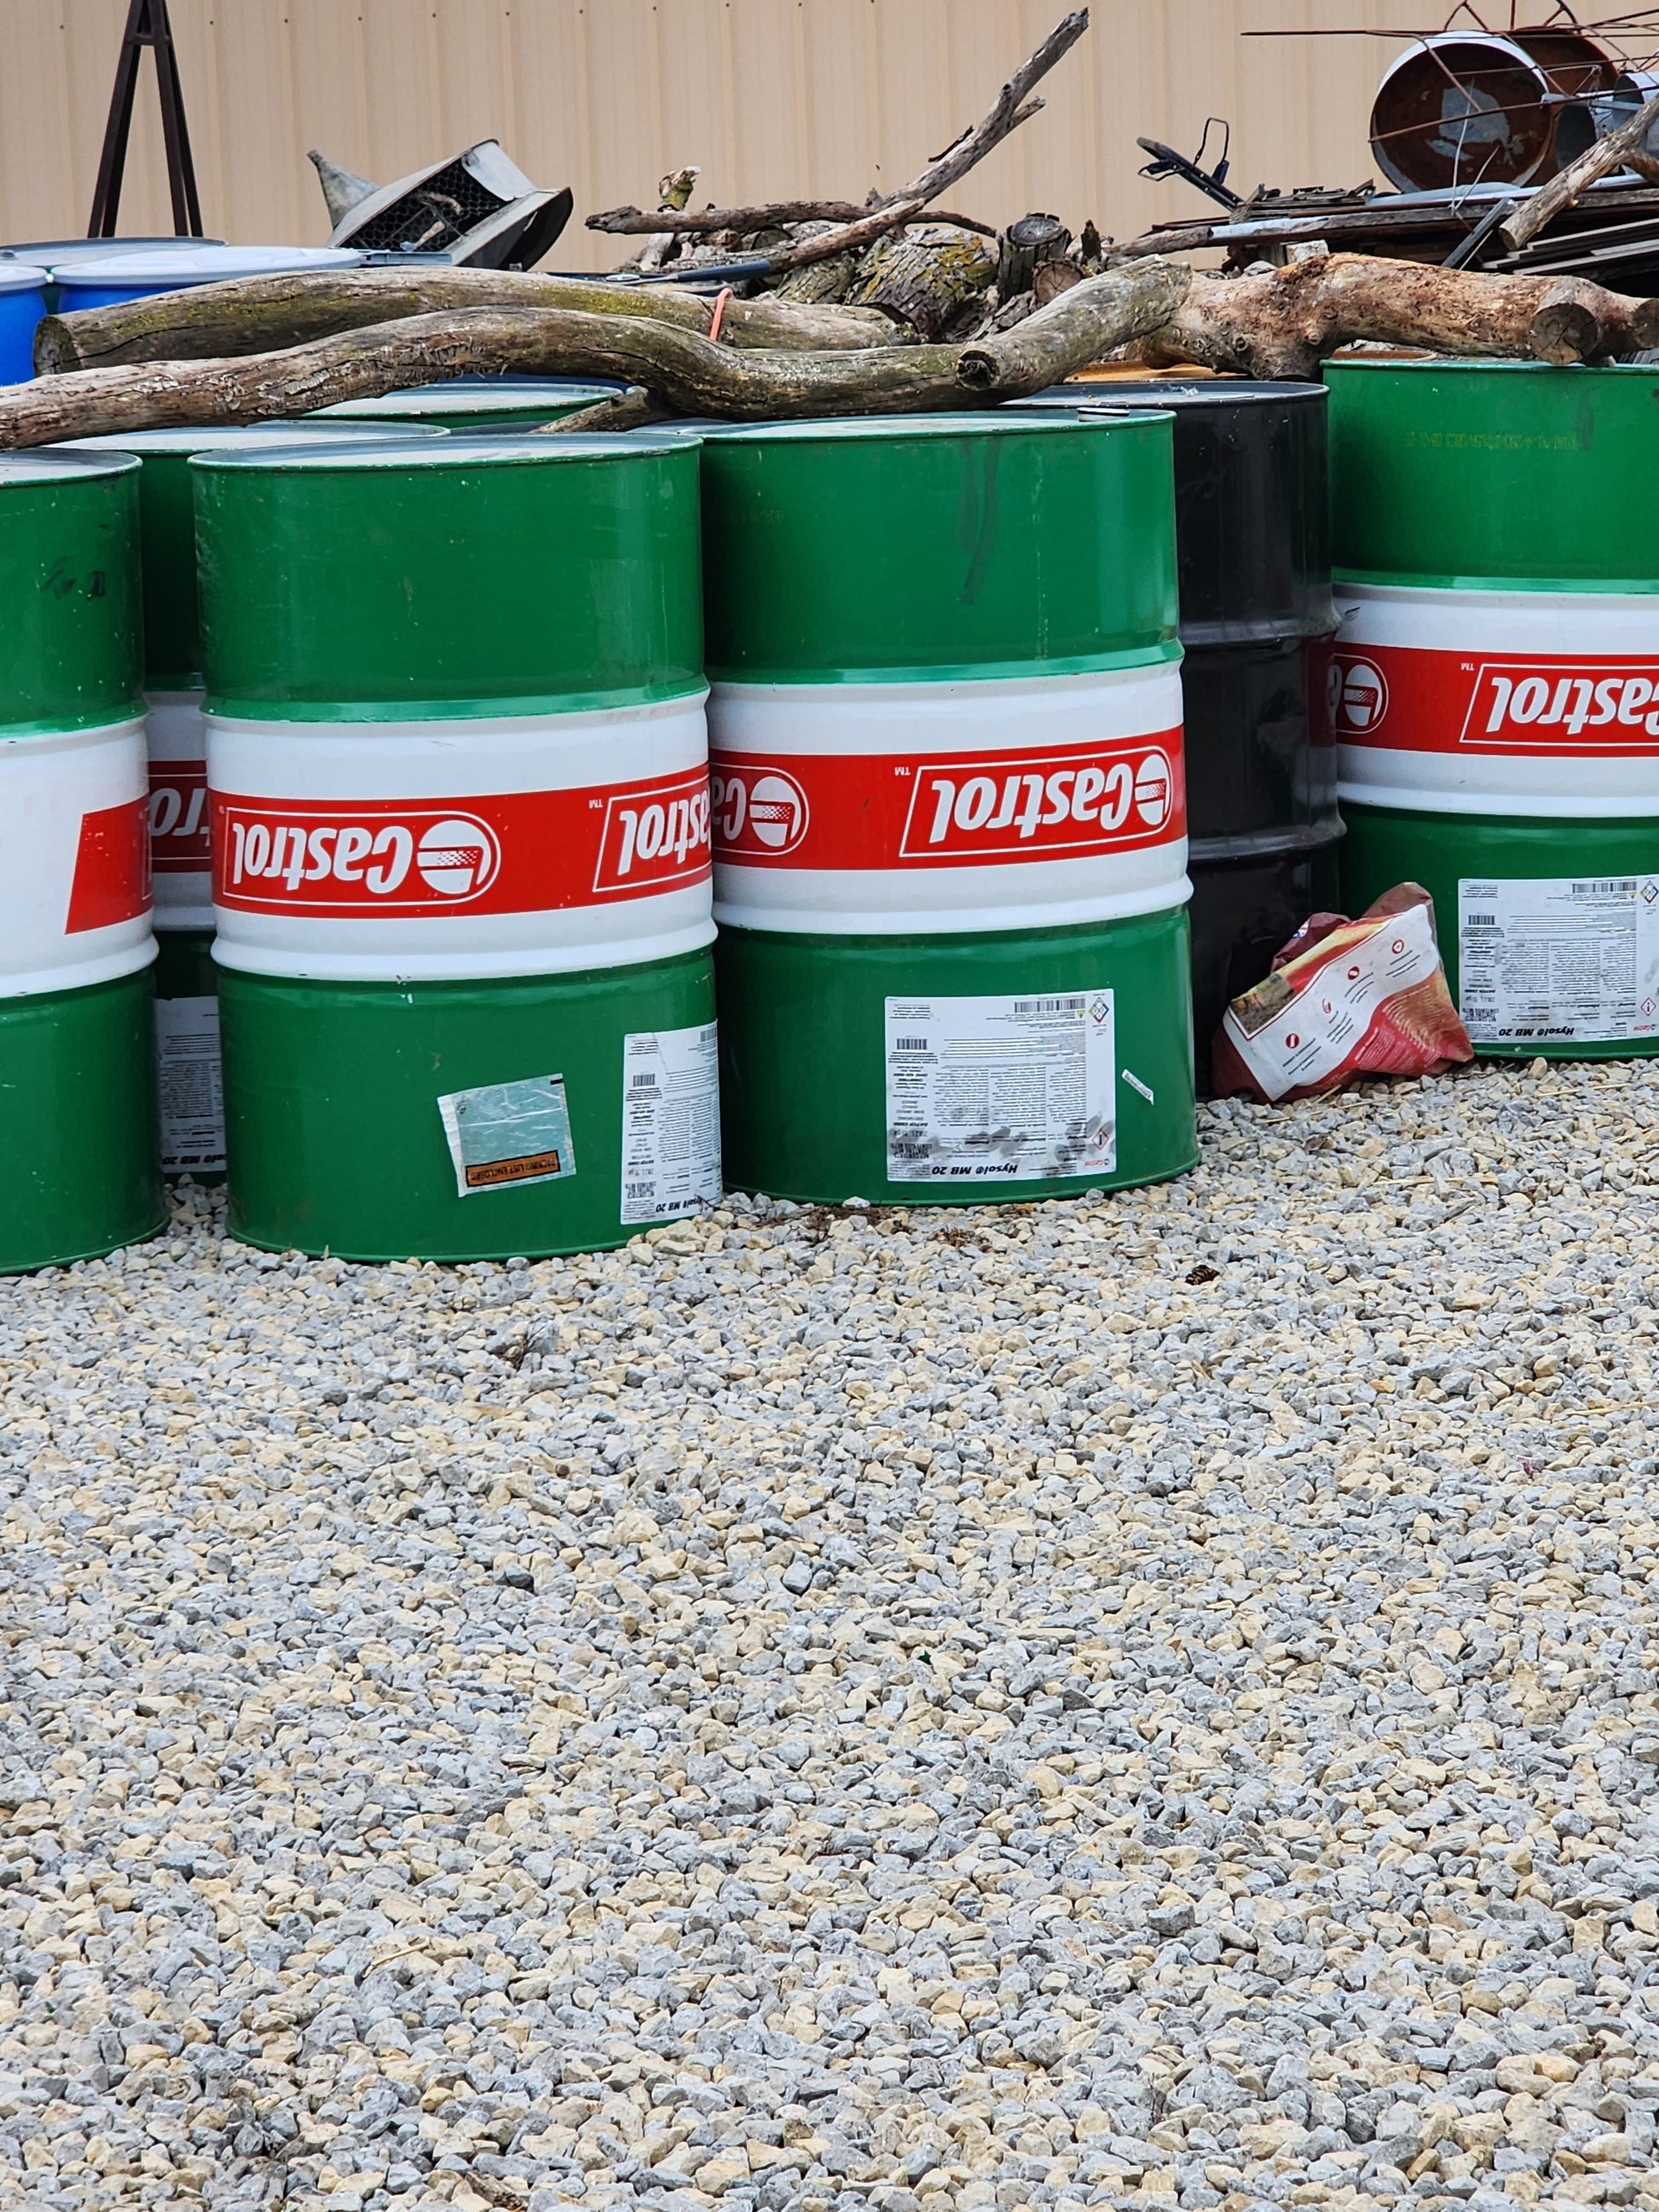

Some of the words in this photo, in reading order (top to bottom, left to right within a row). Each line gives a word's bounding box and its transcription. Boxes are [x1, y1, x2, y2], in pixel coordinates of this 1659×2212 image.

[929, 763, 1133, 844] Castrol
[617, 790, 711, 875] astrol
[231, 823, 413, 894] Castrol
[1499, 1028, 1513, 1037] 20
[470, 1167, 507, 1181] ENCLOSED
[509, 1164, 524, 1174] LIST
[932, 1166, 950, 1175] 20
[951, 1165, 972, 1175] MB
[656, 1203, 667, 1213] 20
